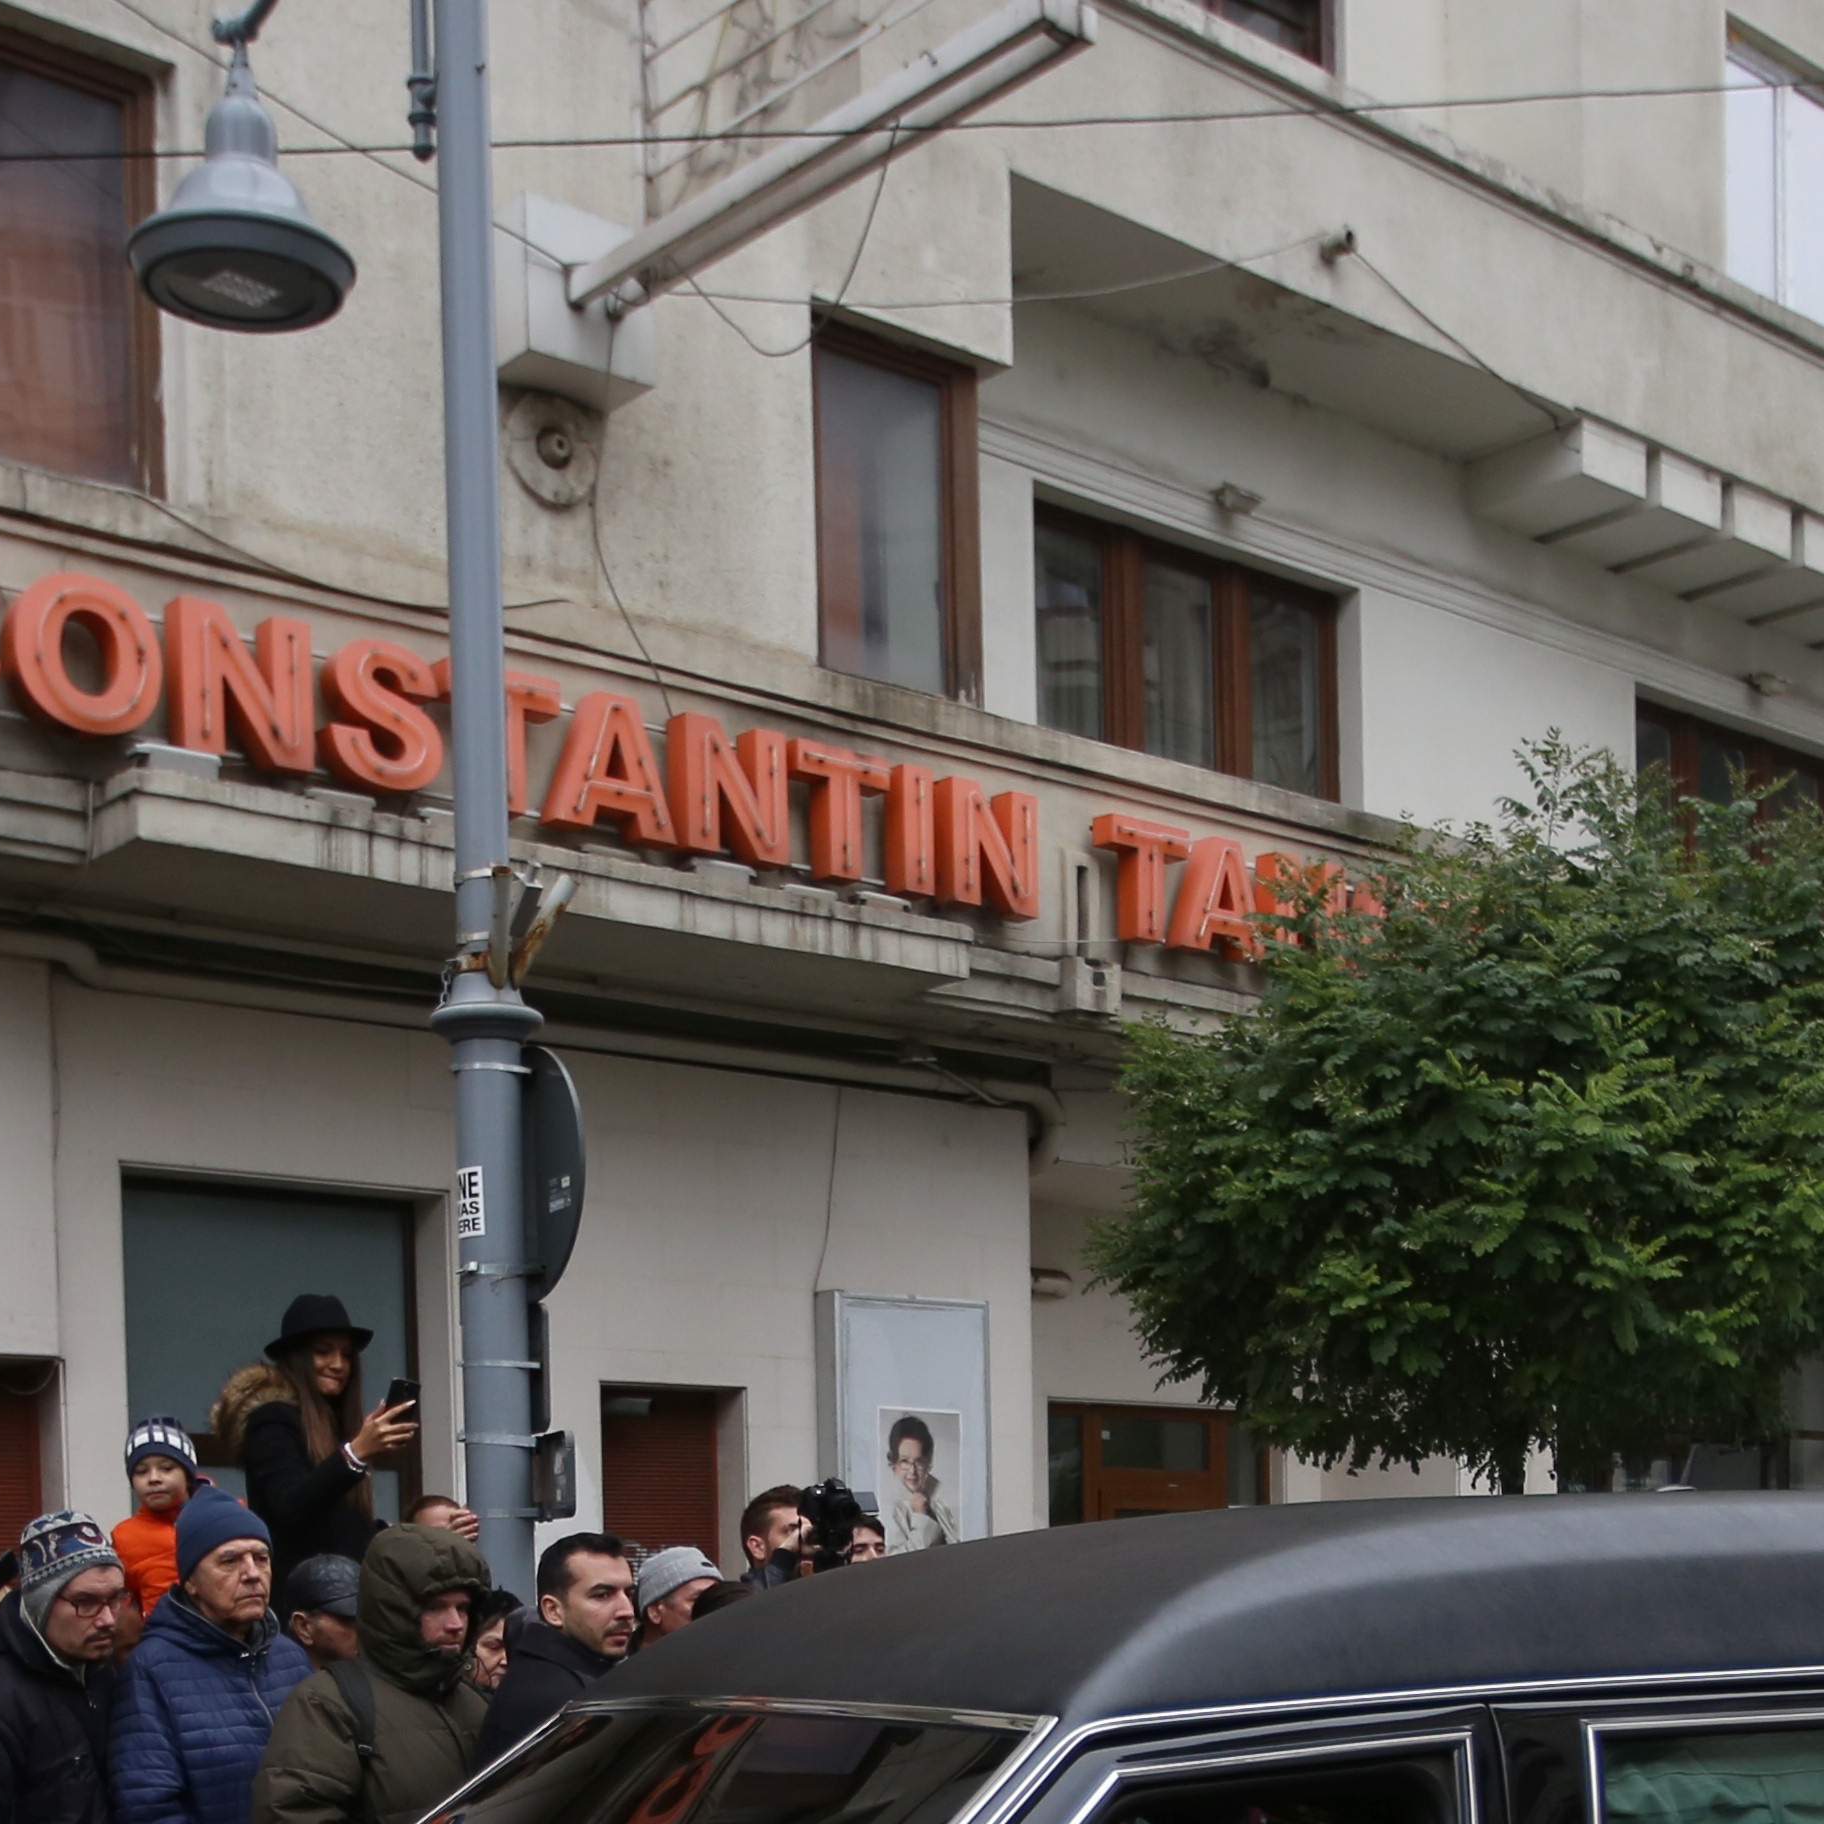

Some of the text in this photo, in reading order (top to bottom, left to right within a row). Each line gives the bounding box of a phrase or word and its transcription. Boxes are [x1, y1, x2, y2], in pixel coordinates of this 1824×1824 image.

[459, 1171, 480, 1199] NE
[459, 1201, 480, 1217] AS
[459, 1217, 481, 1233] ERE
